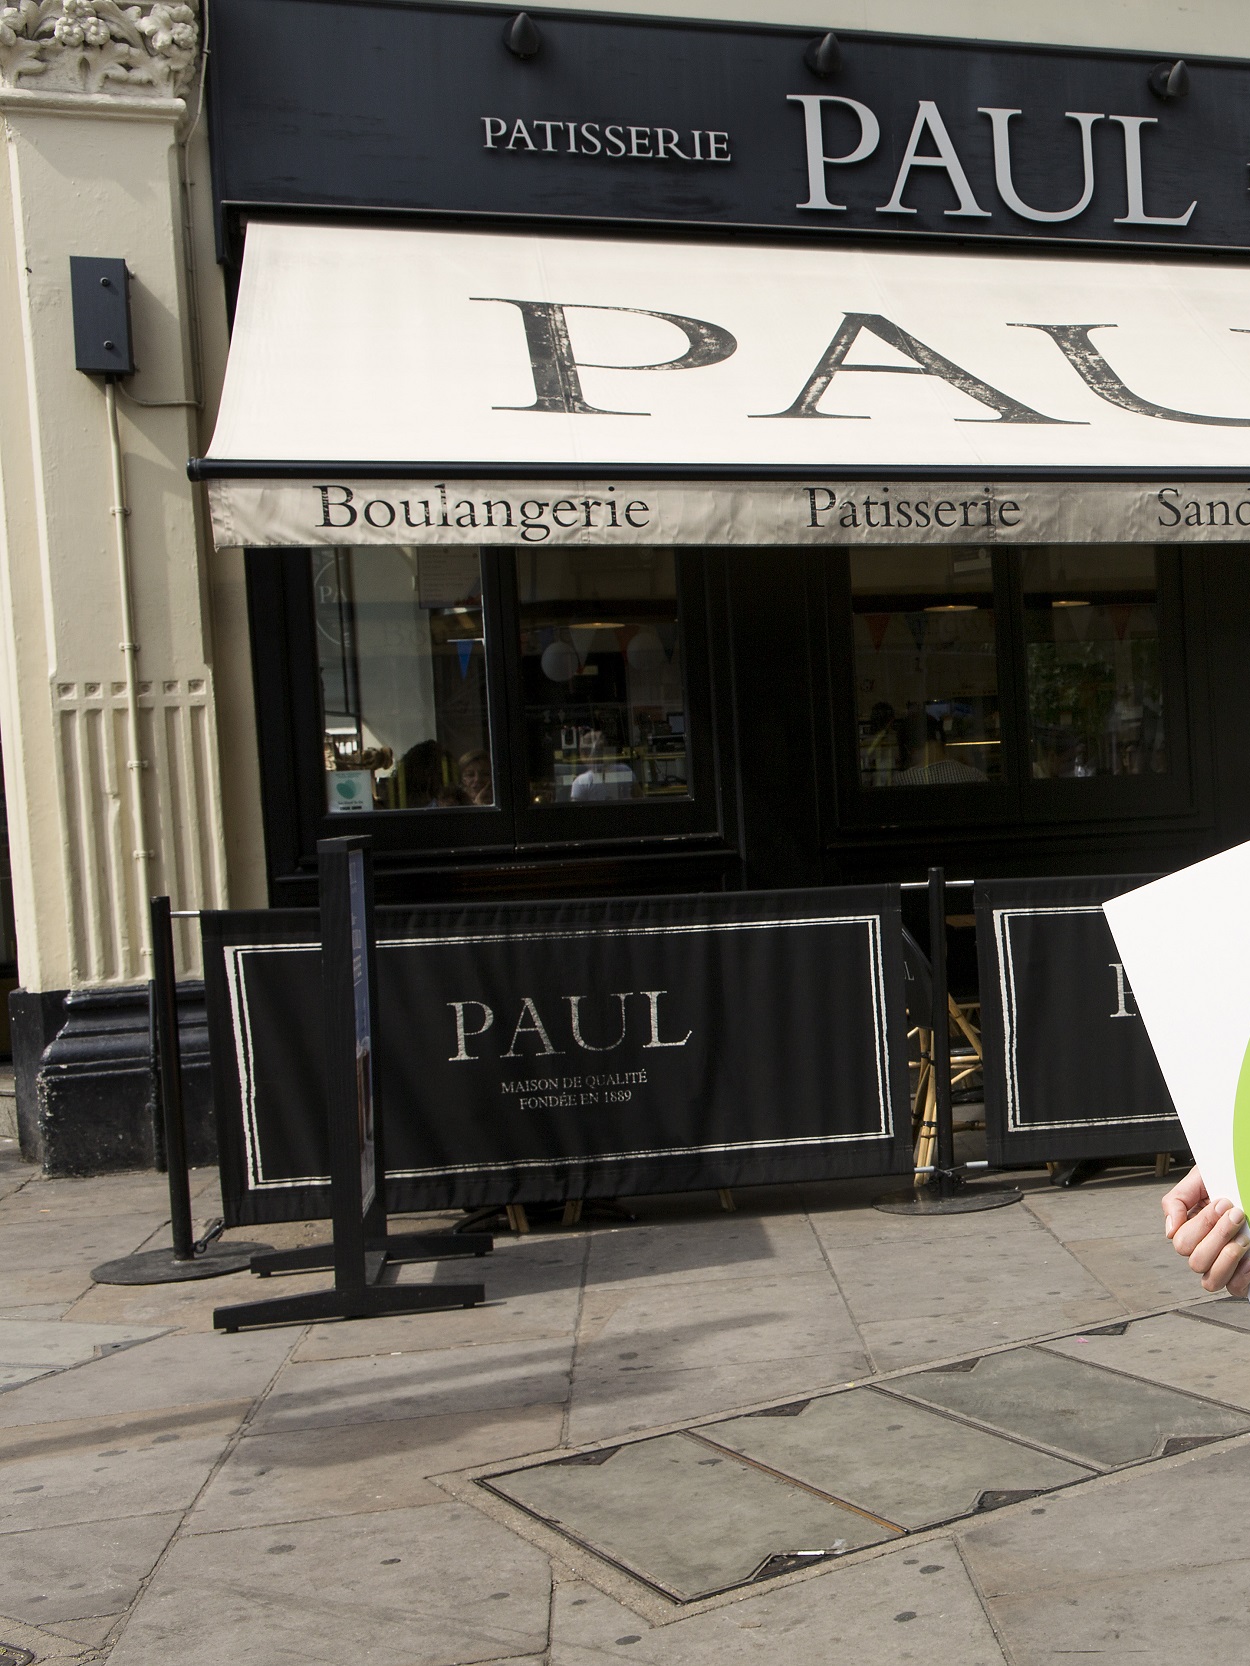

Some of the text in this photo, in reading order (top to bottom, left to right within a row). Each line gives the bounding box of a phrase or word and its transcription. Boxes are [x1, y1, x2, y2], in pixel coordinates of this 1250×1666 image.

[481, 117, 731, 162] PATISSERIE
[785, 94, 1198, 227] PAUL
[314, 484, 650, 542] Boulangerie
[803, 486, 1021, 530] Patisserie
[446, 990, 693, 1062] PAUL
[501, 1068, 648, 1094] MAISON DE QUALITÉ
[520, 1090, 632, 1110] FONDÉE EN 1889
